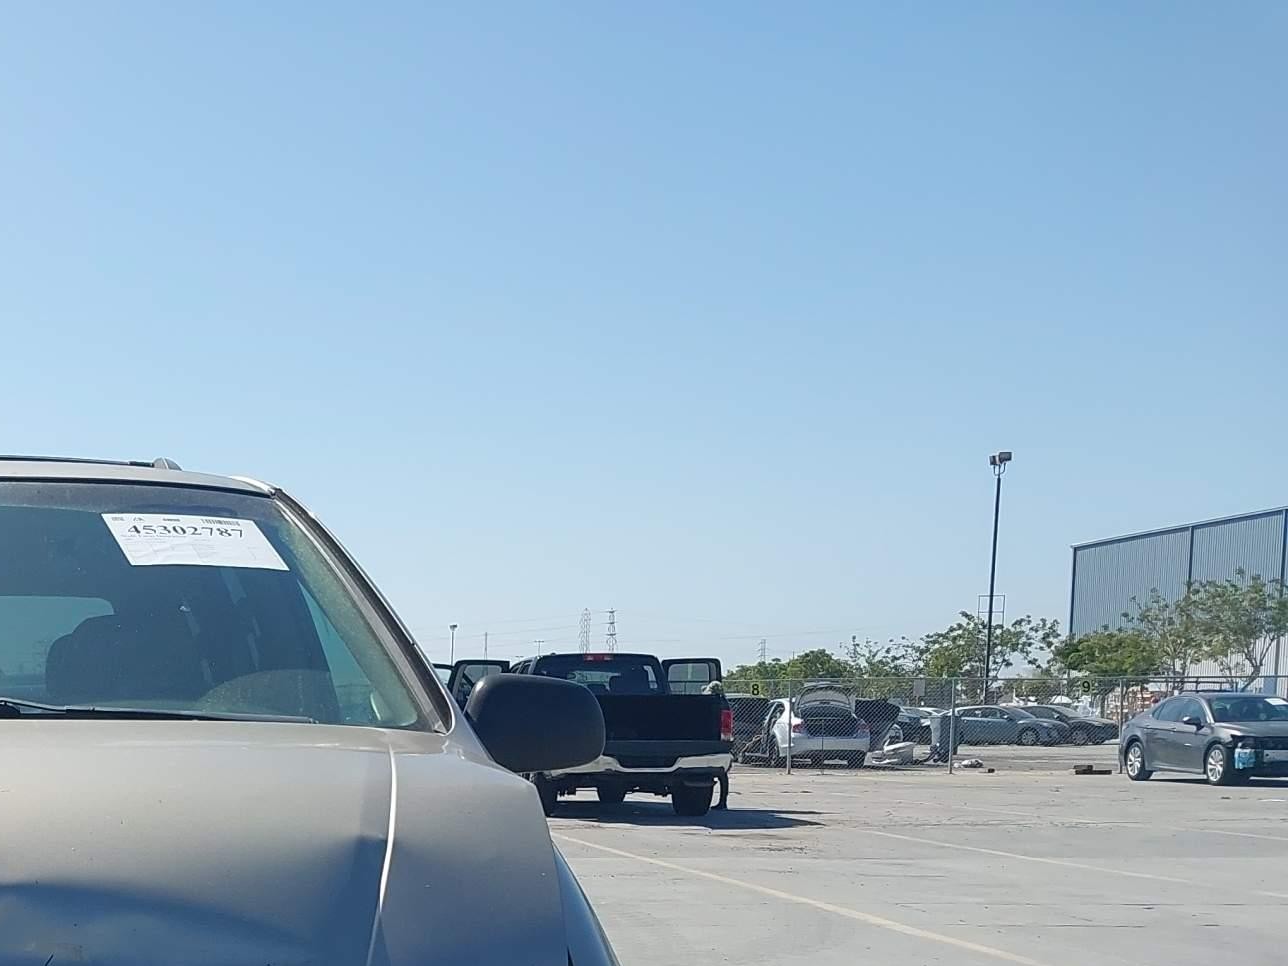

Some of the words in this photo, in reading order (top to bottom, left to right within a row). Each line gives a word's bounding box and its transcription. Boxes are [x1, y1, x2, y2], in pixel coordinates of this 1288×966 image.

[128, 525, 243, 538] 45302787
[751, 683, 760, 696] 8
[1082, 680, 1091, 693] 9
